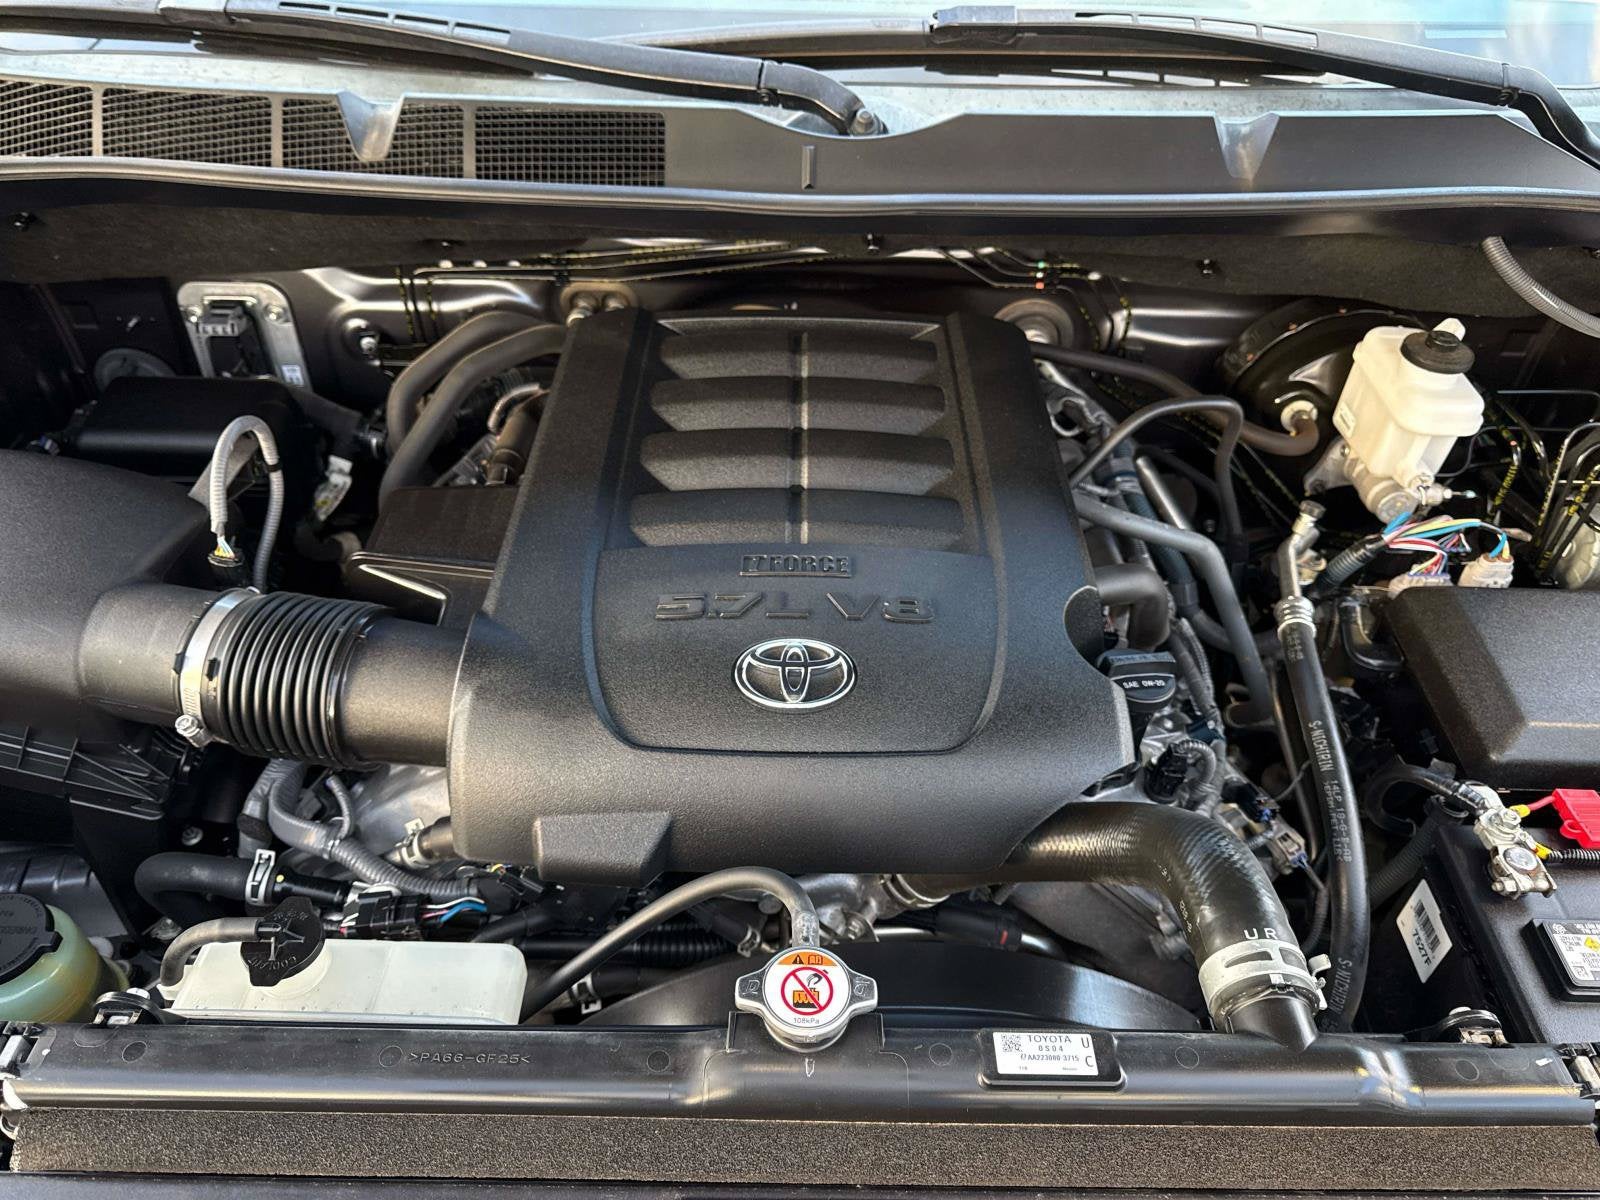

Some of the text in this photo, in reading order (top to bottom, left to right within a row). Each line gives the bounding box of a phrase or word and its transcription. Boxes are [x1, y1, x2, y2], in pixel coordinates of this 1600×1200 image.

[825, 591, 935, 625] V8
[1122, 680, 1140, 689] SAE
[1026, 1034, 1072, 1044] TOYOTA
[1080, 1037, 1090, 1049] U
[1085, 1055, 1095, 1068] C
